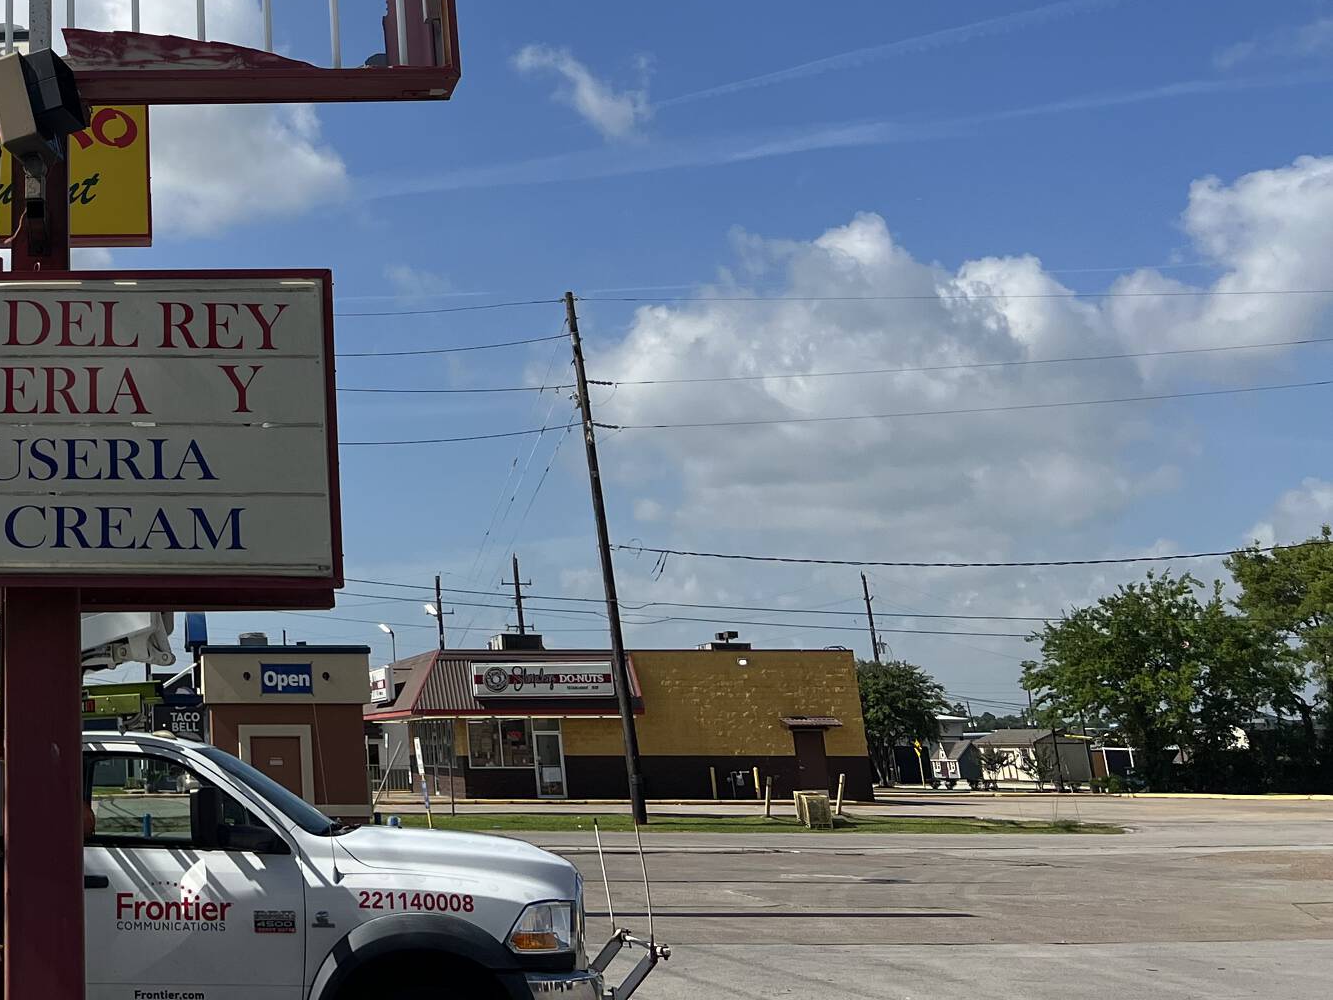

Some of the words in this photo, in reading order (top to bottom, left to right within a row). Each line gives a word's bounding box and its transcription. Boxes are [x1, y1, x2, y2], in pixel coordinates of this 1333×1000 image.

[2, 300, 139, 349] DEL
[157, 302, 290, 350] REY
[218, 365, 264, 413] Y
[3, 505, 247, 551] CREAM
[263, 670, 311, 691] Open
[559, 674, 604, 683] DO-NUTS
[170, 712, 200, 722] TACO
[171, 722, 199, 732] BELL
[116, 893, 232, 921] Frontier
[358, 891, 474, 912] 221140008
[116, 921, 226, 932] COMMUNICATIONS
[134, 990, 205, 1000] Frontier.com
